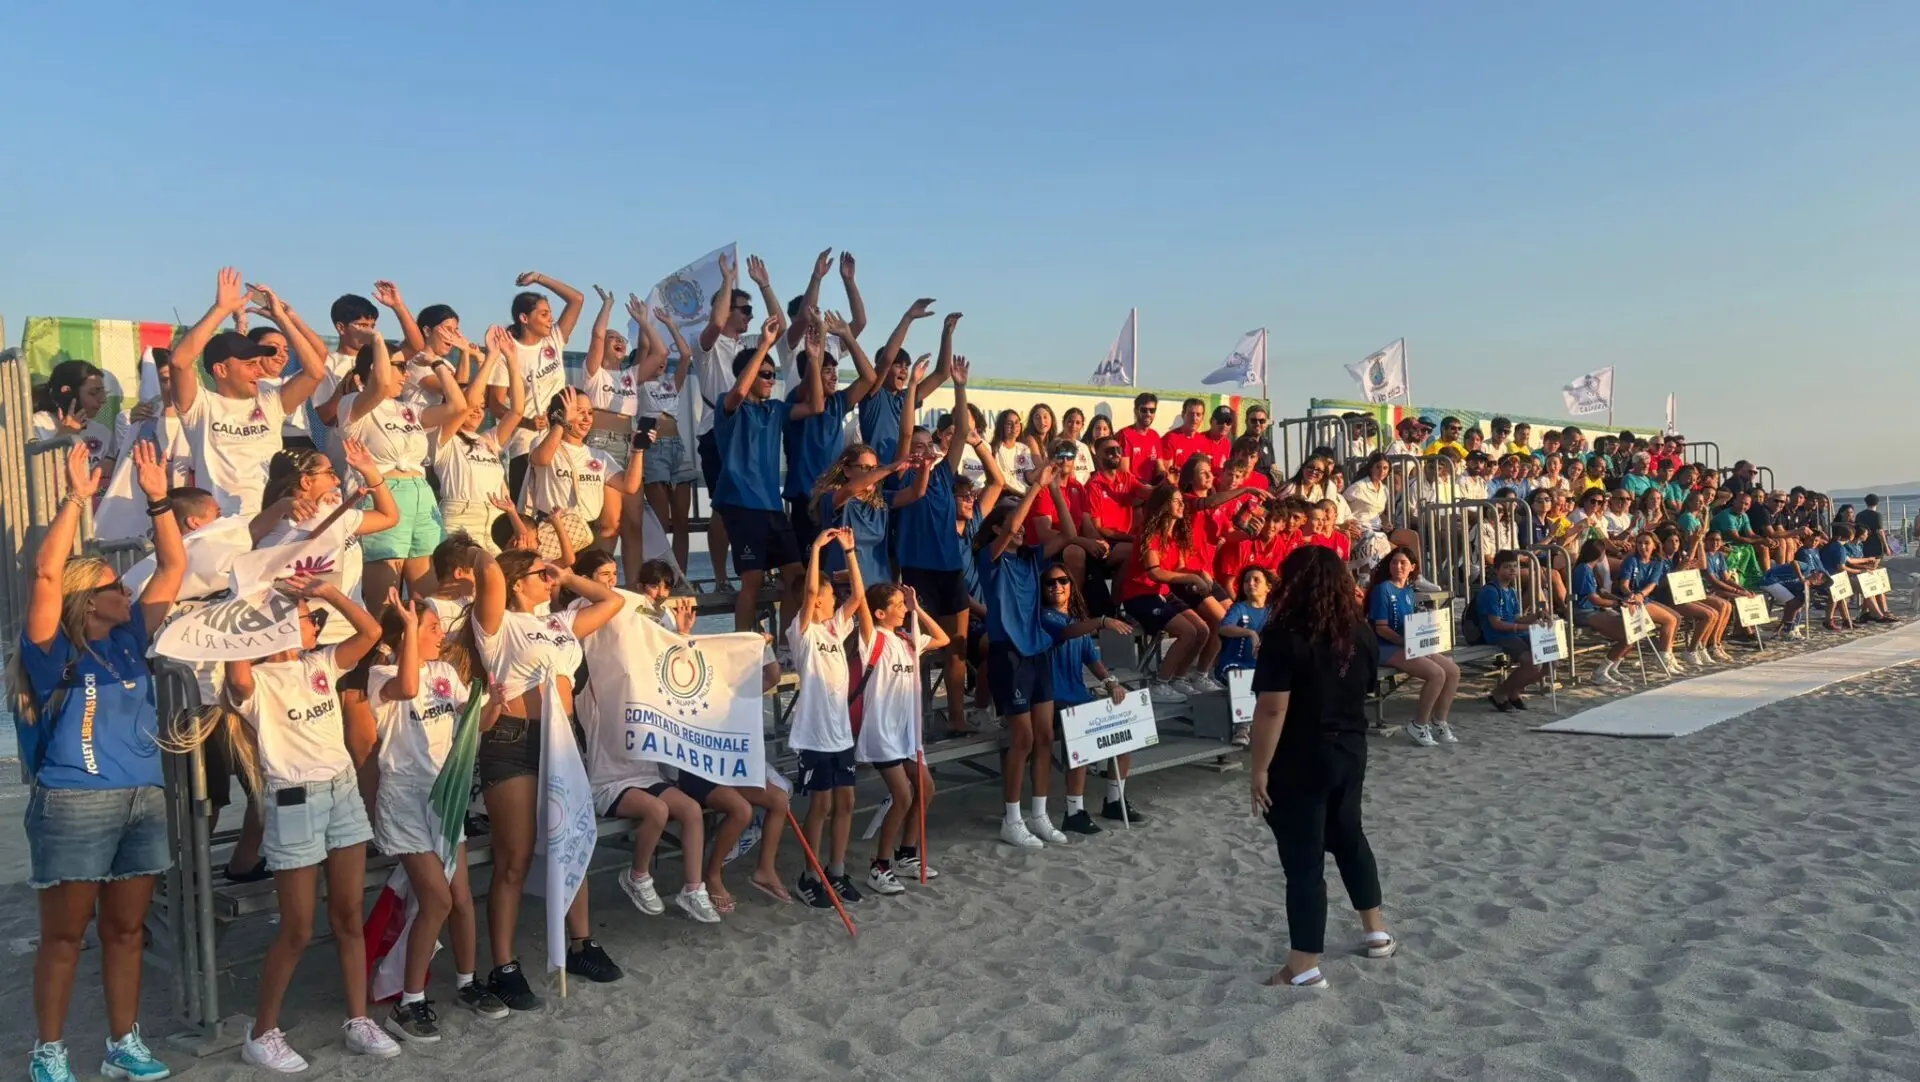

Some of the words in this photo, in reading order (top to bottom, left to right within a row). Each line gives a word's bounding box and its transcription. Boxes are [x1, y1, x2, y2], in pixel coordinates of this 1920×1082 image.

[211, 422, 270, 437] CALABRIA
[556, 468, 602, 482] CALBRIA
[624, 708, 680, 737] COMITATO
[681, 726, 750, 753] REGIONALE
[1096, 729, 1133, 750] CALABRIA
[625, 730, 748, 778] CALABRIA
